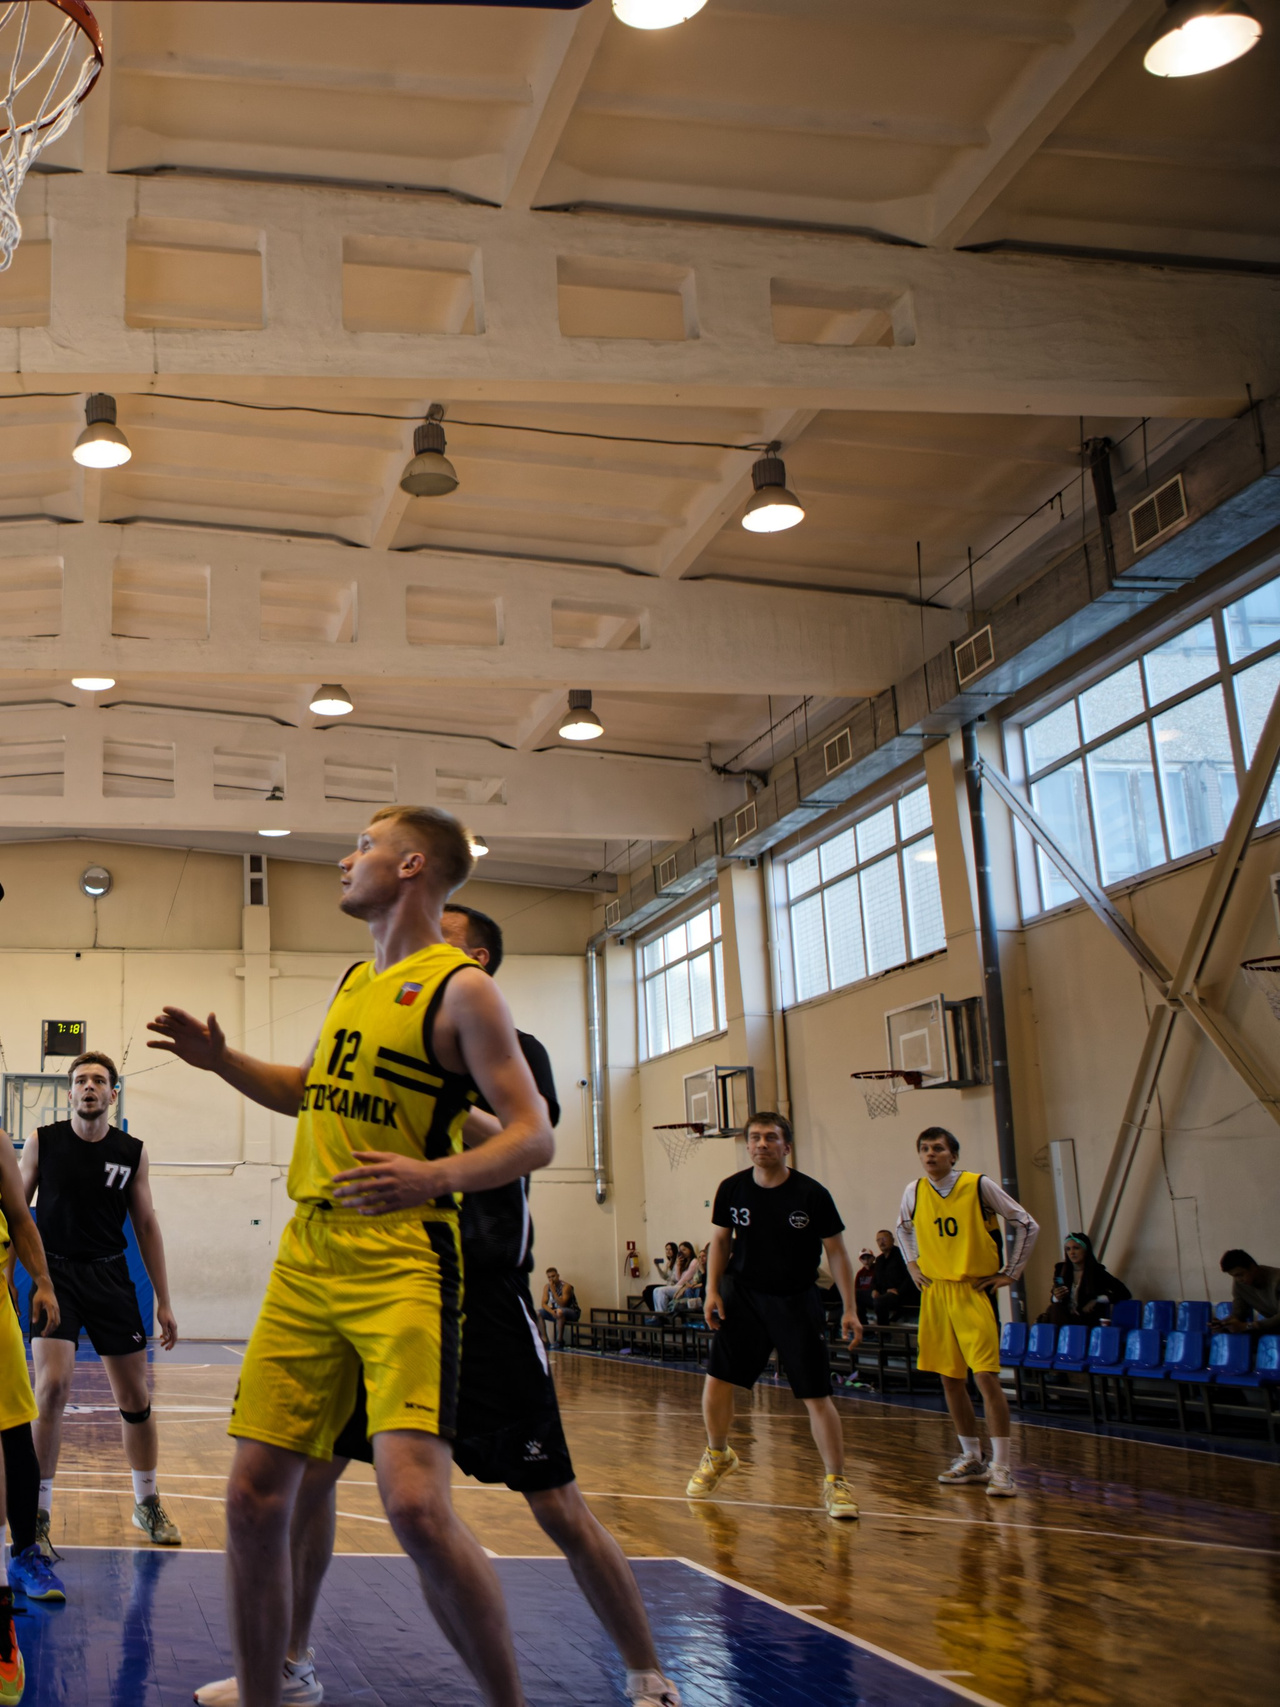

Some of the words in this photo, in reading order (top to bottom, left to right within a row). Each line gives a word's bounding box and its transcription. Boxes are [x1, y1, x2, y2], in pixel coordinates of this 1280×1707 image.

[58, 1024, 80, 1034] 7:18
[327, 1029, 362, 1081] 12
[104, 1161, 131, 1190] 77
[934, 1217, 958, 1237] 10
